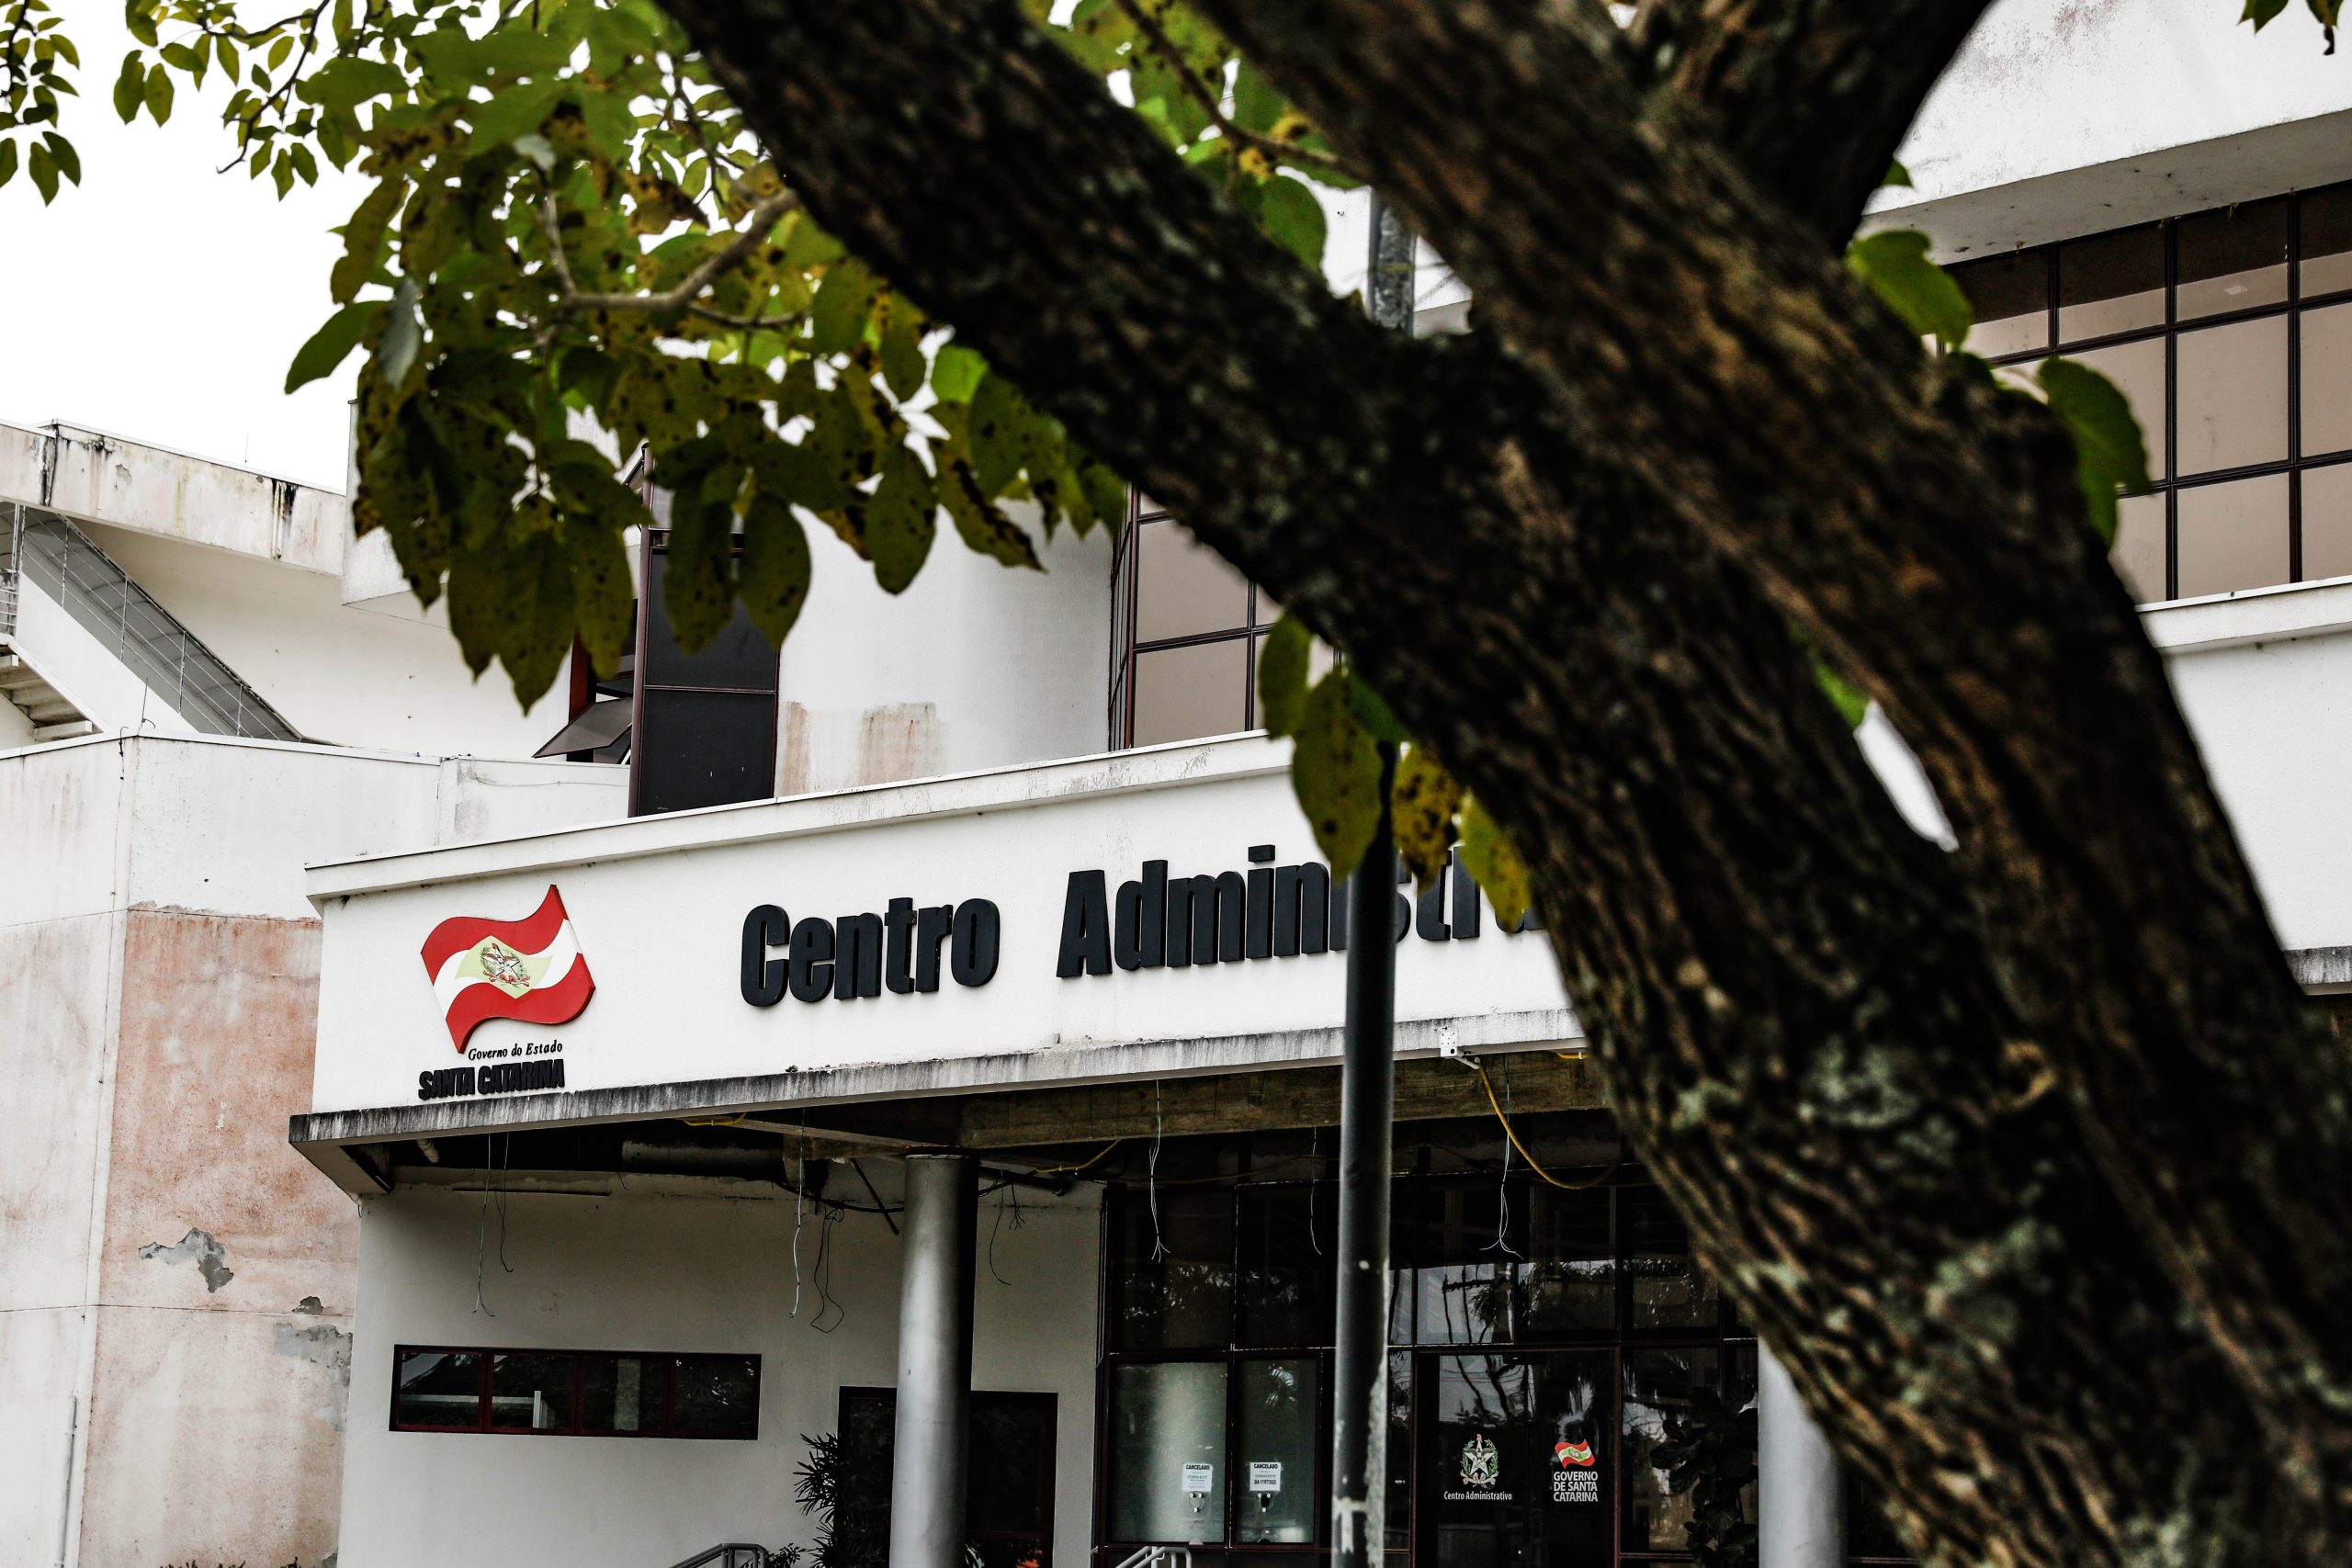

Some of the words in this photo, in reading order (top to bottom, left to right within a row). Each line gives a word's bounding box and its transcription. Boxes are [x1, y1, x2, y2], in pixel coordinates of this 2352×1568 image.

[741, 897, 1001, 1007] Centro
[468, 1048, 508, 1060] Governo
[511, 1043, 523, 1056] do
[526, 1040, 563, 1055] Estado
[418, 1067, 476, 1100] SANTA
[477, 1059, 565, 1094] CATARINA
[1553, 1471, 1599, 1482] GOVERNO
[1554, 1481, 1566, 1492] DE
[1567, 1481, 1599, 1492] SANTA
[1443, 1491, 1465, 1500] Centro
[1465, 1491, 1512, 1500] Administrativo
[1553, 1491, 1599, 1502] CATARINA
